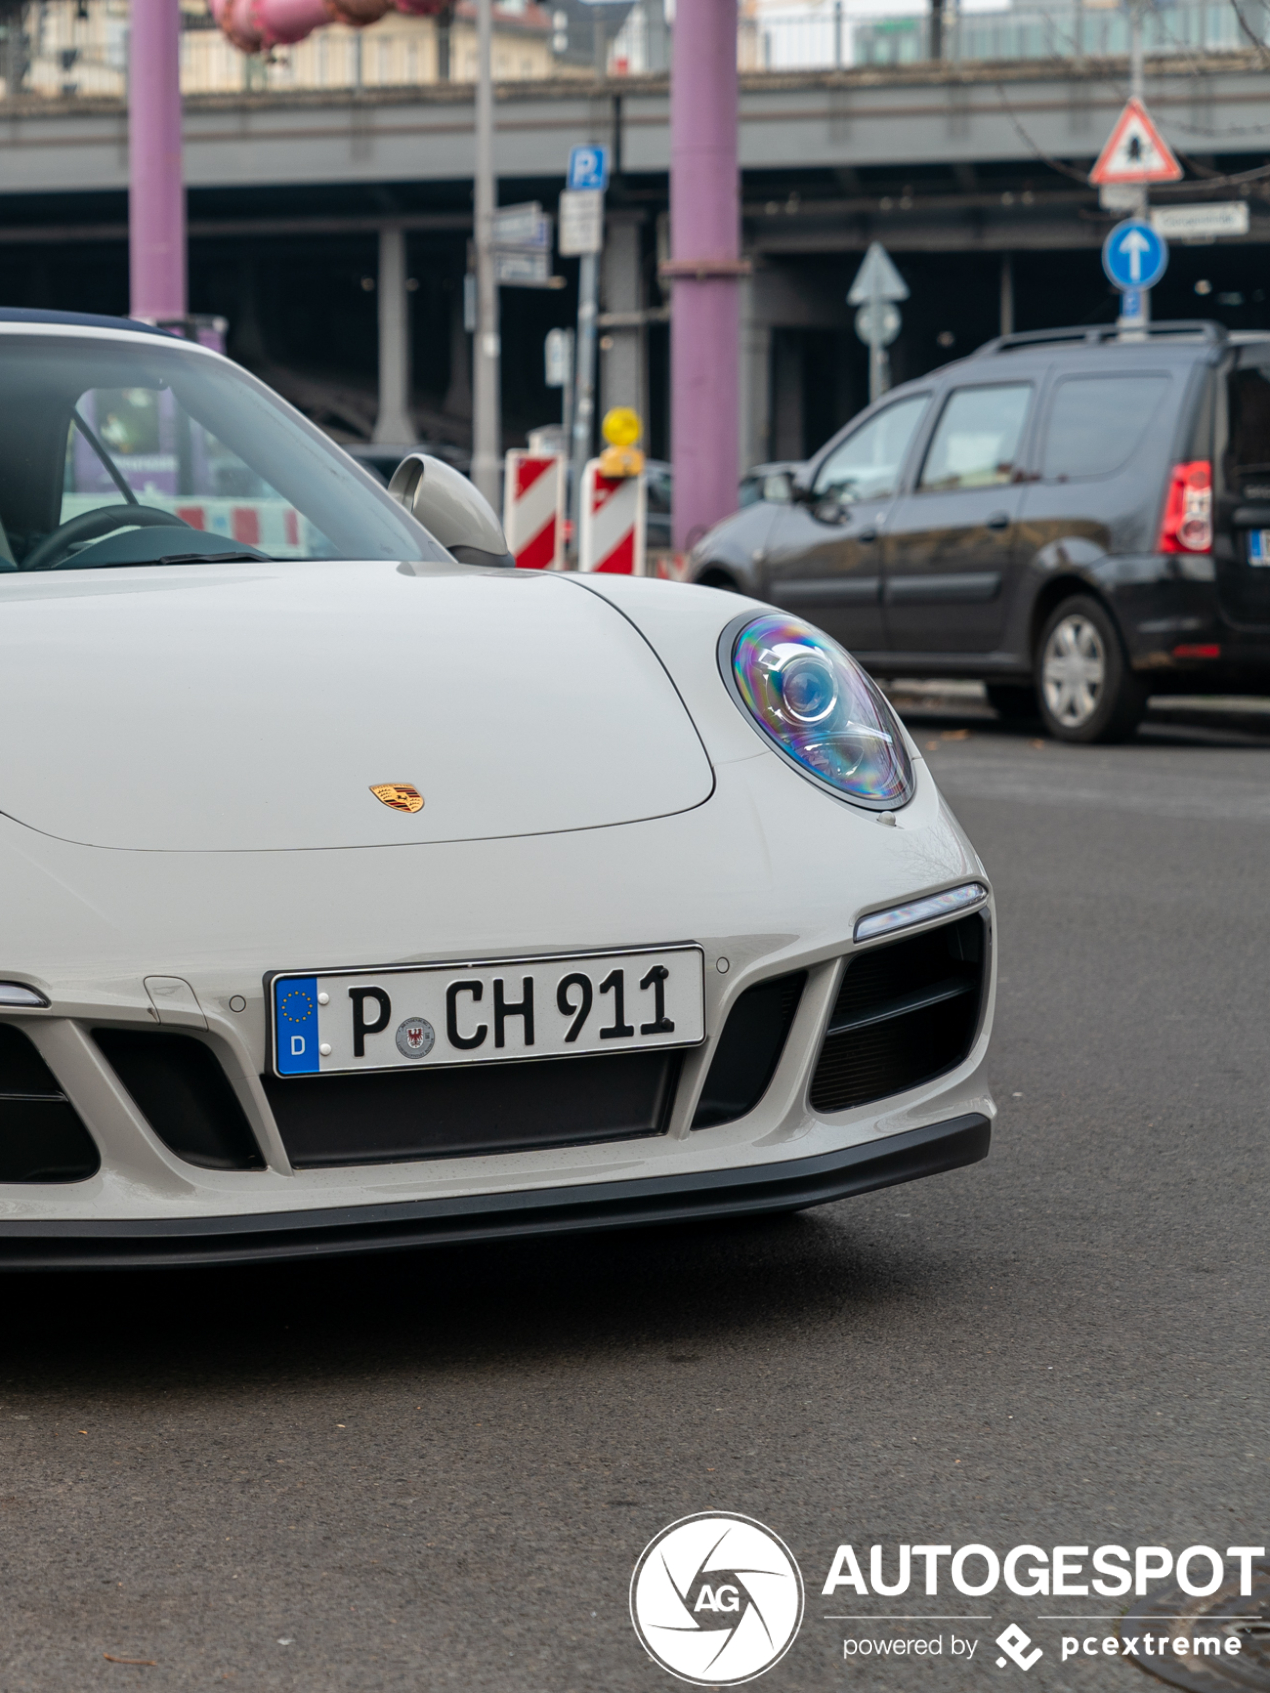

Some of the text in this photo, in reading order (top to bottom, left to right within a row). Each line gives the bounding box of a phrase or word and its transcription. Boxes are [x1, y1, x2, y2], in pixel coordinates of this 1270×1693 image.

[348, 964, 675, 1058] P CH 911
[290, 1035, 306, 1056] D
